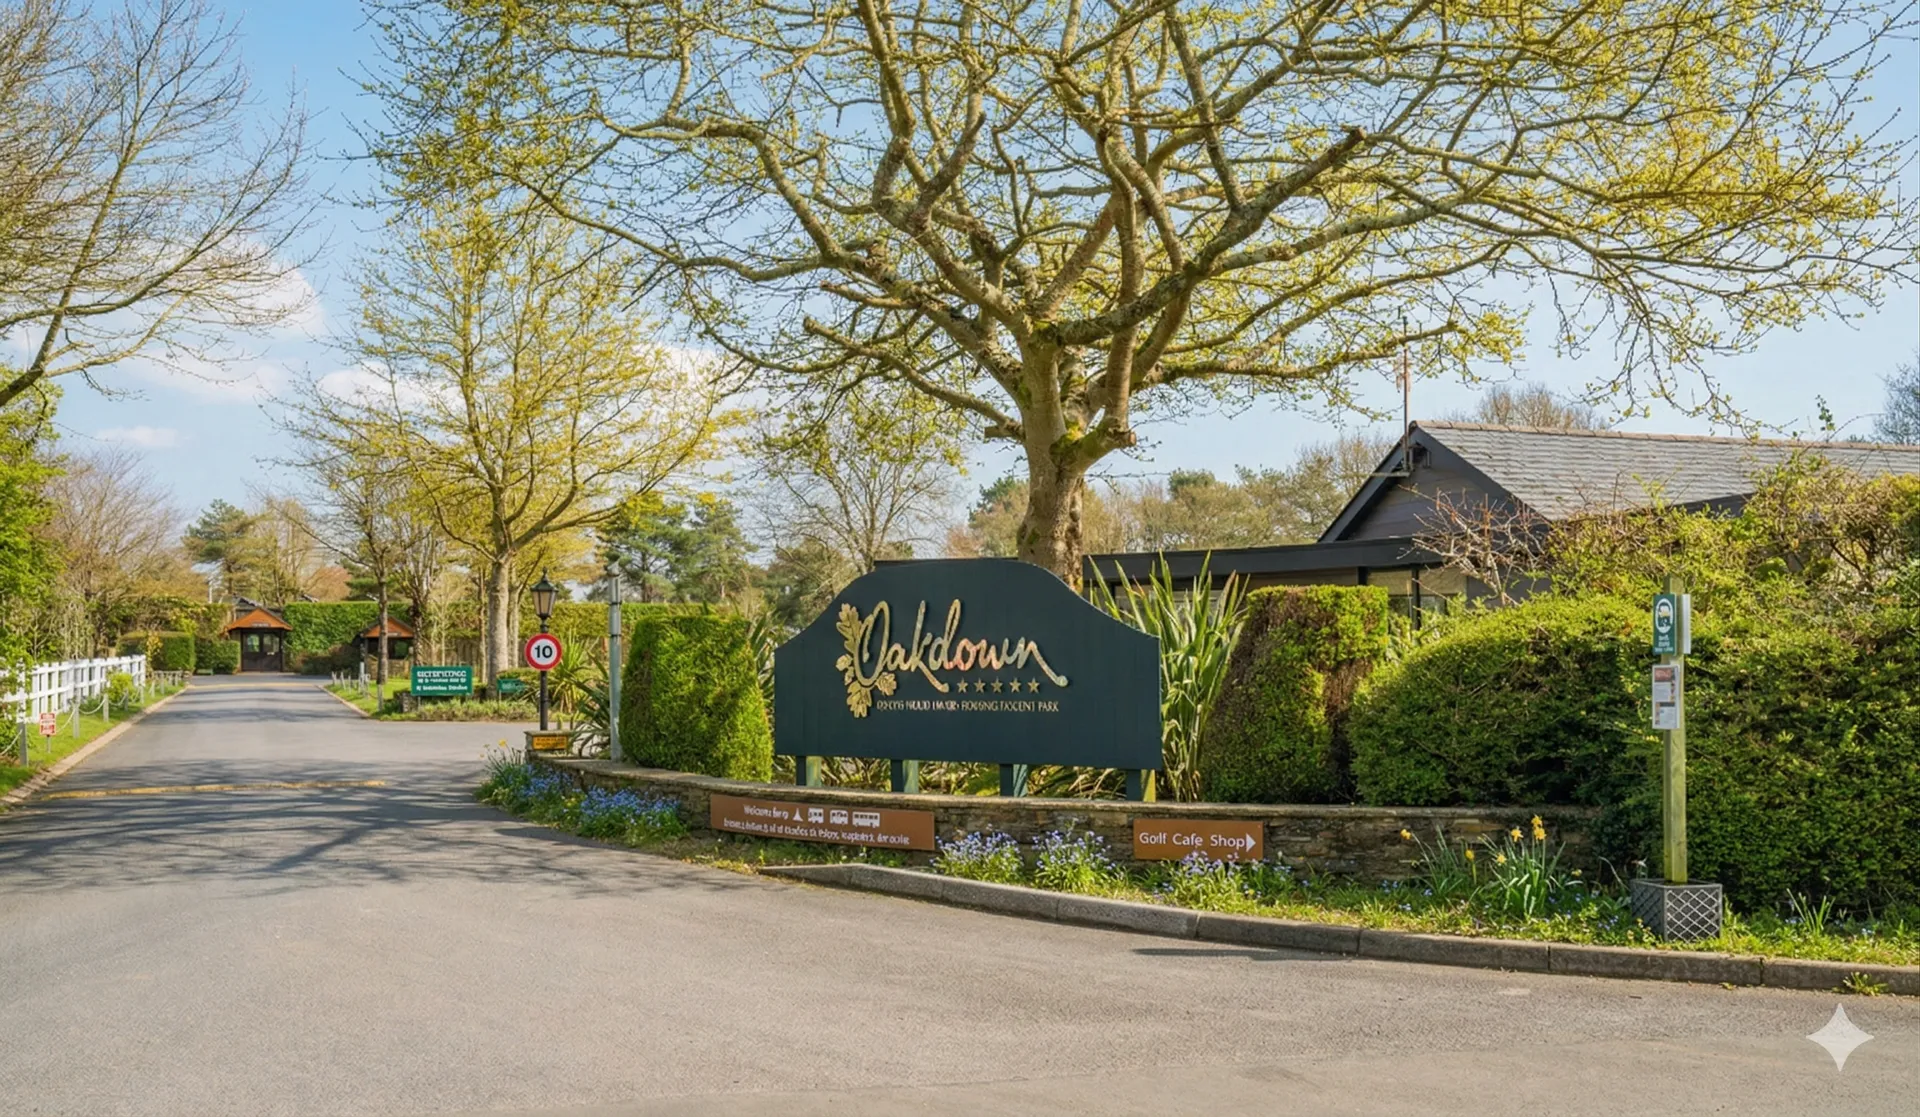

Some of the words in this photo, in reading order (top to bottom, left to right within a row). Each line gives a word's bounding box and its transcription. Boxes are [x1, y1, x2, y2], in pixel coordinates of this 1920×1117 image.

[534, 645, 553, 659] 10
[854, 599, 1069, 693] Oakdown
[1139, 832, 1168, 845] Golf
[1172, 833, 1204, 846] Cafe
[1210, 834, 1246, 851] Shop
